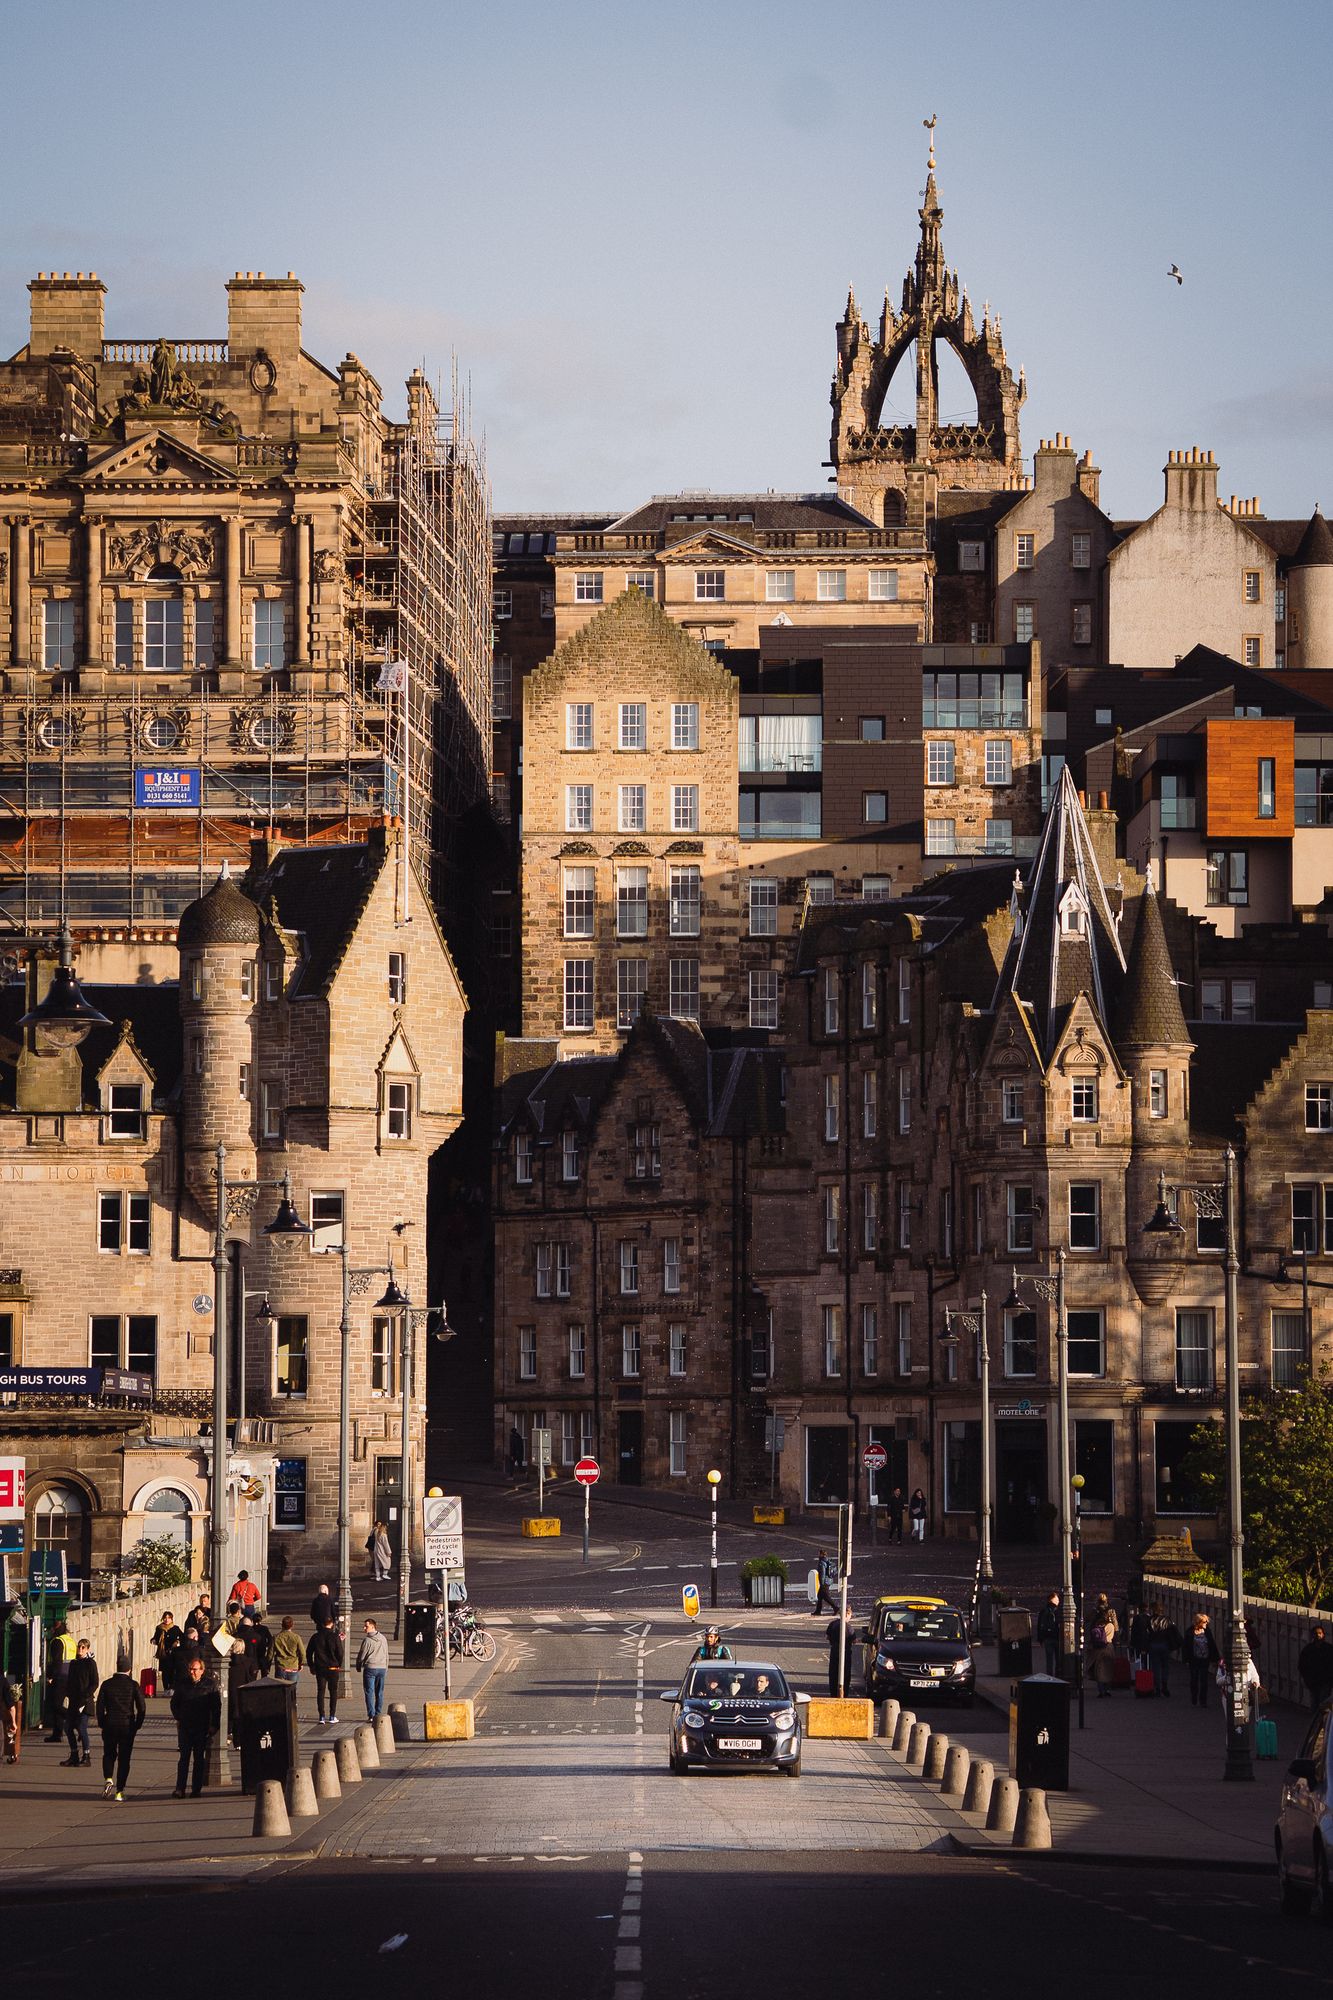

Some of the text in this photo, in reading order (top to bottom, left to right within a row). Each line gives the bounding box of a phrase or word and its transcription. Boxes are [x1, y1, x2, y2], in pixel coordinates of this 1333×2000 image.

[155, 772, 179, 786] J&I
[48, 1166, 133, 1180] HOTEL
[20, 1375, 43, 1385] BUS
[46, 1375, 87, 1385] TOURS
